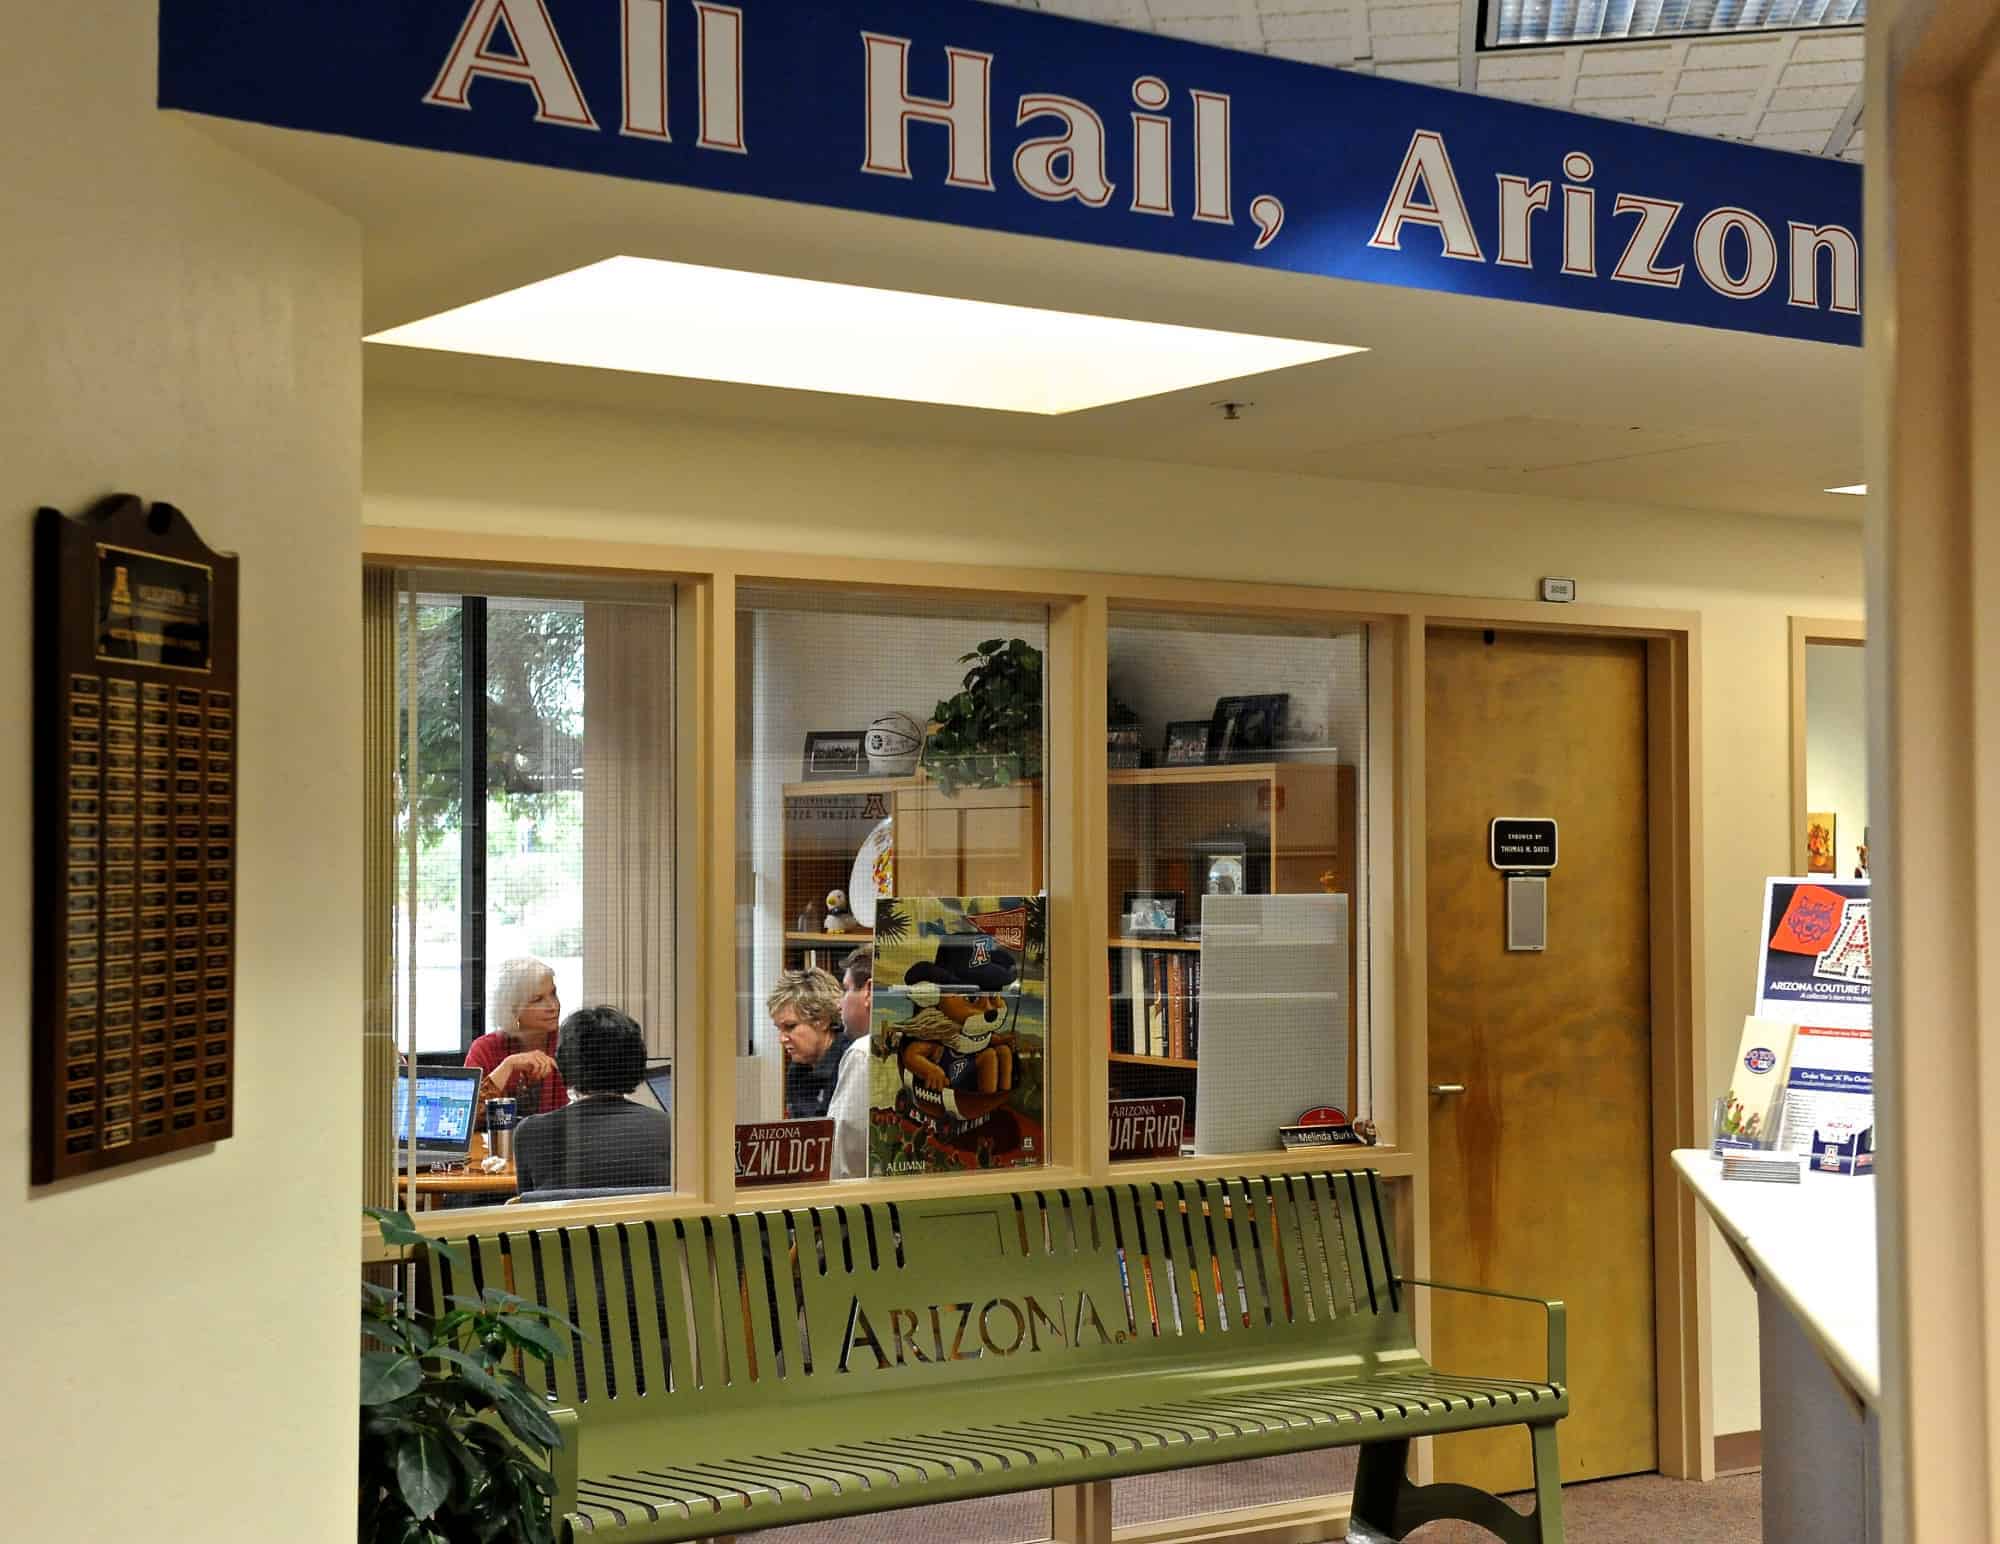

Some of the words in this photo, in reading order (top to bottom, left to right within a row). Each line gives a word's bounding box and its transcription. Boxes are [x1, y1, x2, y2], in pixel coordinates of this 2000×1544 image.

[422, 0, 747, 153] All
[861, 31, 1284, 249] Hail,
[1367, 129, 1861, 315] Arizon
[1770, 981, 1813, 992] ARIZONA
[1814, 983, 1860, 994] COUTURE
[1112, 1104, 1156, 1117] ARIZONA
[750, 1127, 801, 1140] ARIZONA
[1110, 1115, 1179, 1151] UAFRVR
[1298, 1131, 1331, 1143] Melinda
[745, 1137, 831, 1177] ZWLDCT
[886, 1160, 926, 1172] ALUMNI
[837, 1289, 1113, 1373] ARIZONA
